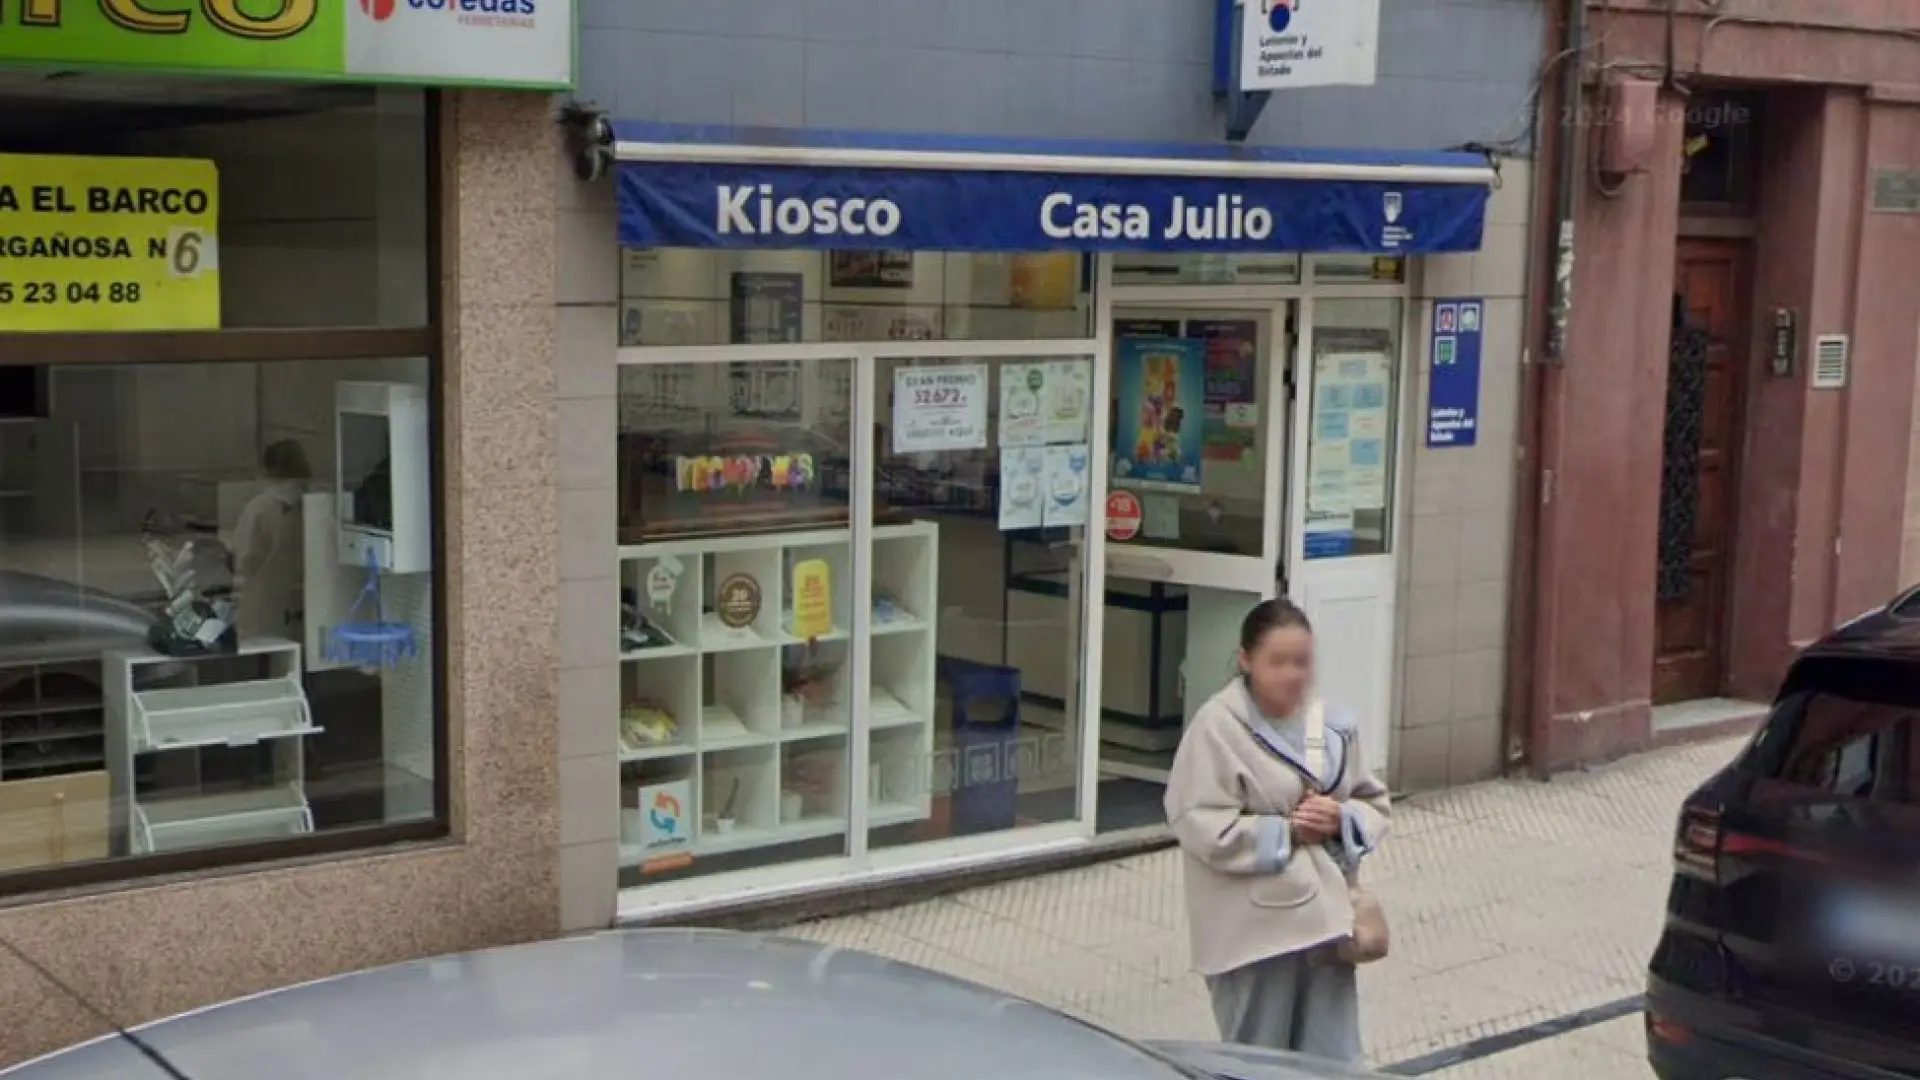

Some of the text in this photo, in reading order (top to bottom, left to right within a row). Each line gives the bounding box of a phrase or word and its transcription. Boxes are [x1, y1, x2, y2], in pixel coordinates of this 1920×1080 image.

[32, 186, 76, 213] EL
[87, 187, 208, 214] BARCO
[716, 184, 1273, 240] Kiosco Casa Julio
[0, 232, 132, 258] GAÑOSA
[24, 283, 57, 304] 23
[67, 282, 100, 304] 04
[109, 282, 140, 303] 88
